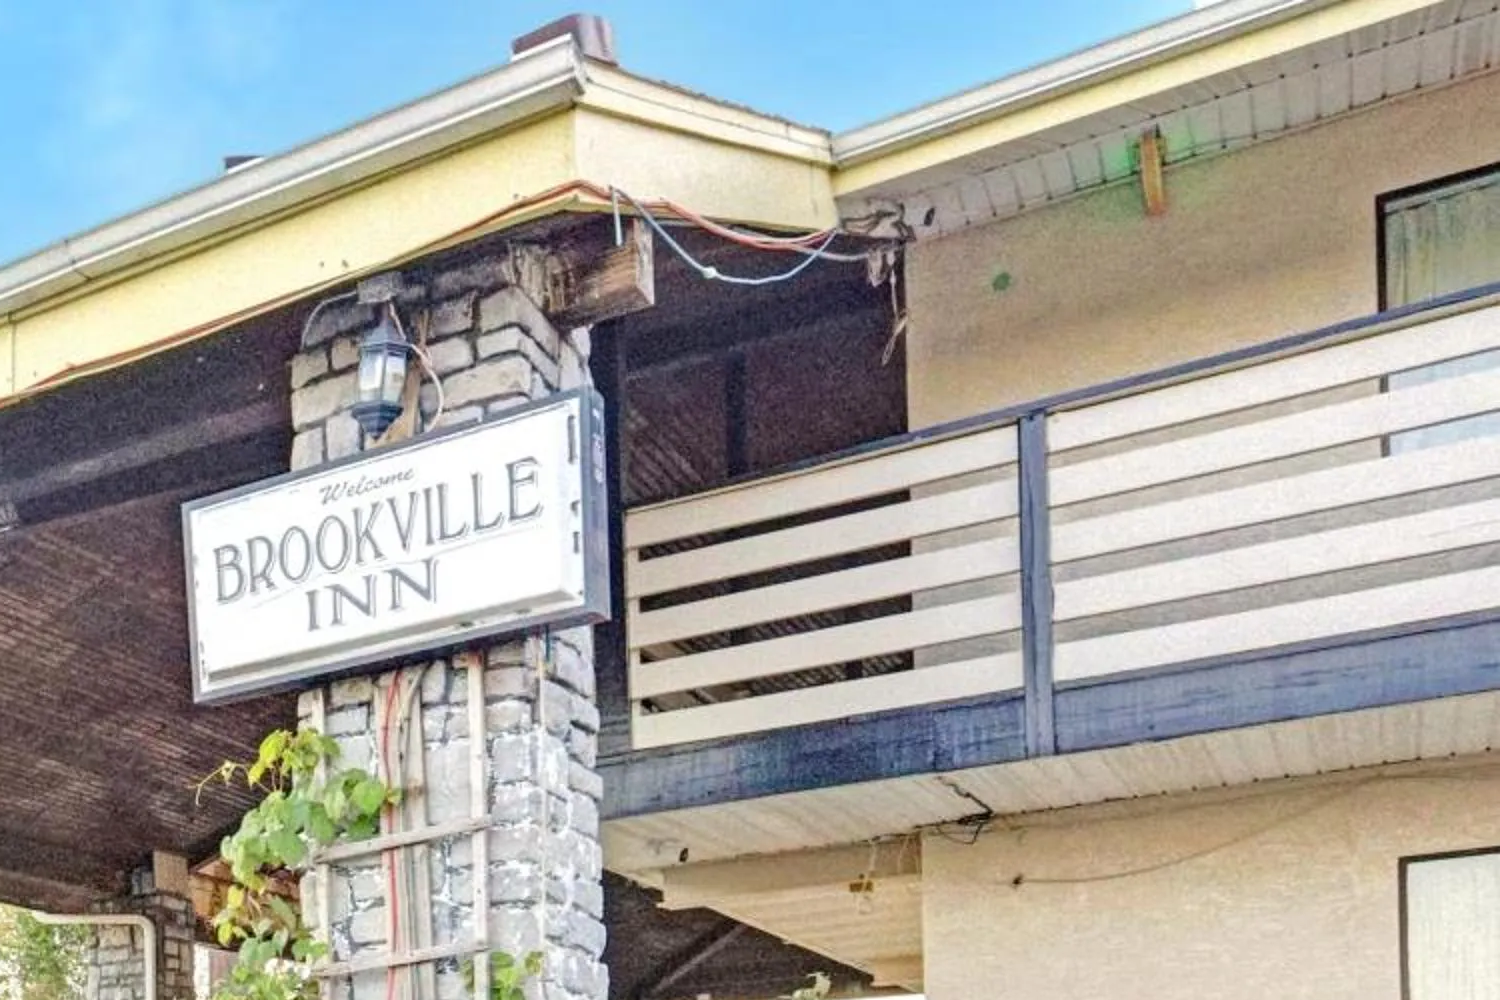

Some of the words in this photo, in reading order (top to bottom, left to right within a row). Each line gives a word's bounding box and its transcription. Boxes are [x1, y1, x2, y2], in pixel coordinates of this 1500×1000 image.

[320, 469, 414, 504] Welcome
[214, 456, 543, 603] BROOKVILLE
[306, 557, 438, 631] INN
